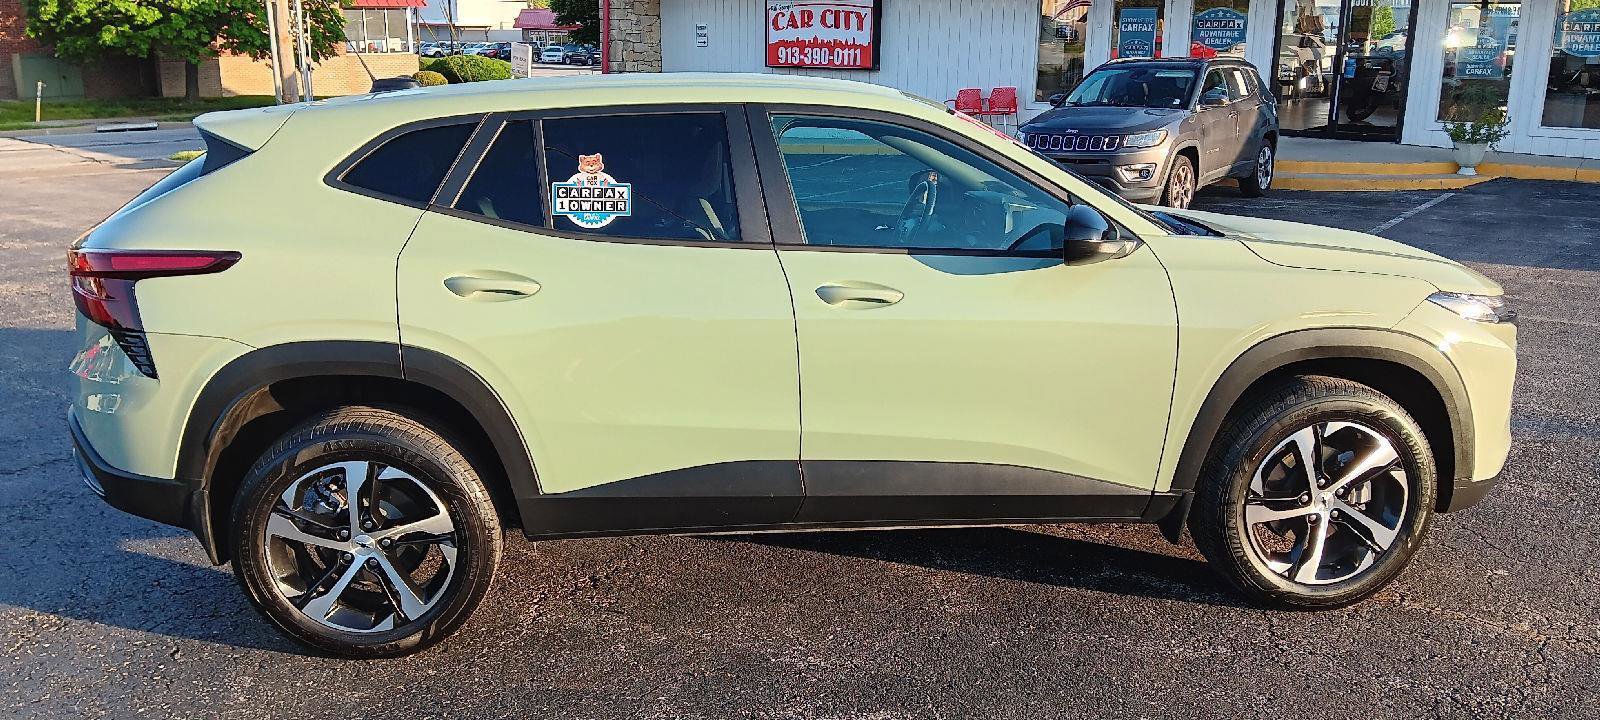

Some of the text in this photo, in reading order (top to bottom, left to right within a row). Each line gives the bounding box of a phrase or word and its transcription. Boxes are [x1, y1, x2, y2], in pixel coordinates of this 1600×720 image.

[772, 9, 867, 31] CAR CITY
[1197, 20, 1244, 29] CARFAX
[1122, 23, 1153, 32] CARFAX
[1200, 30, 1240, 38] ADVANTAGE
[778, 46, 861, 66] 913-390-0111
[557, 187, 627, 199] CARFAX
[559, 200, 627, 211] 1 OWNER
